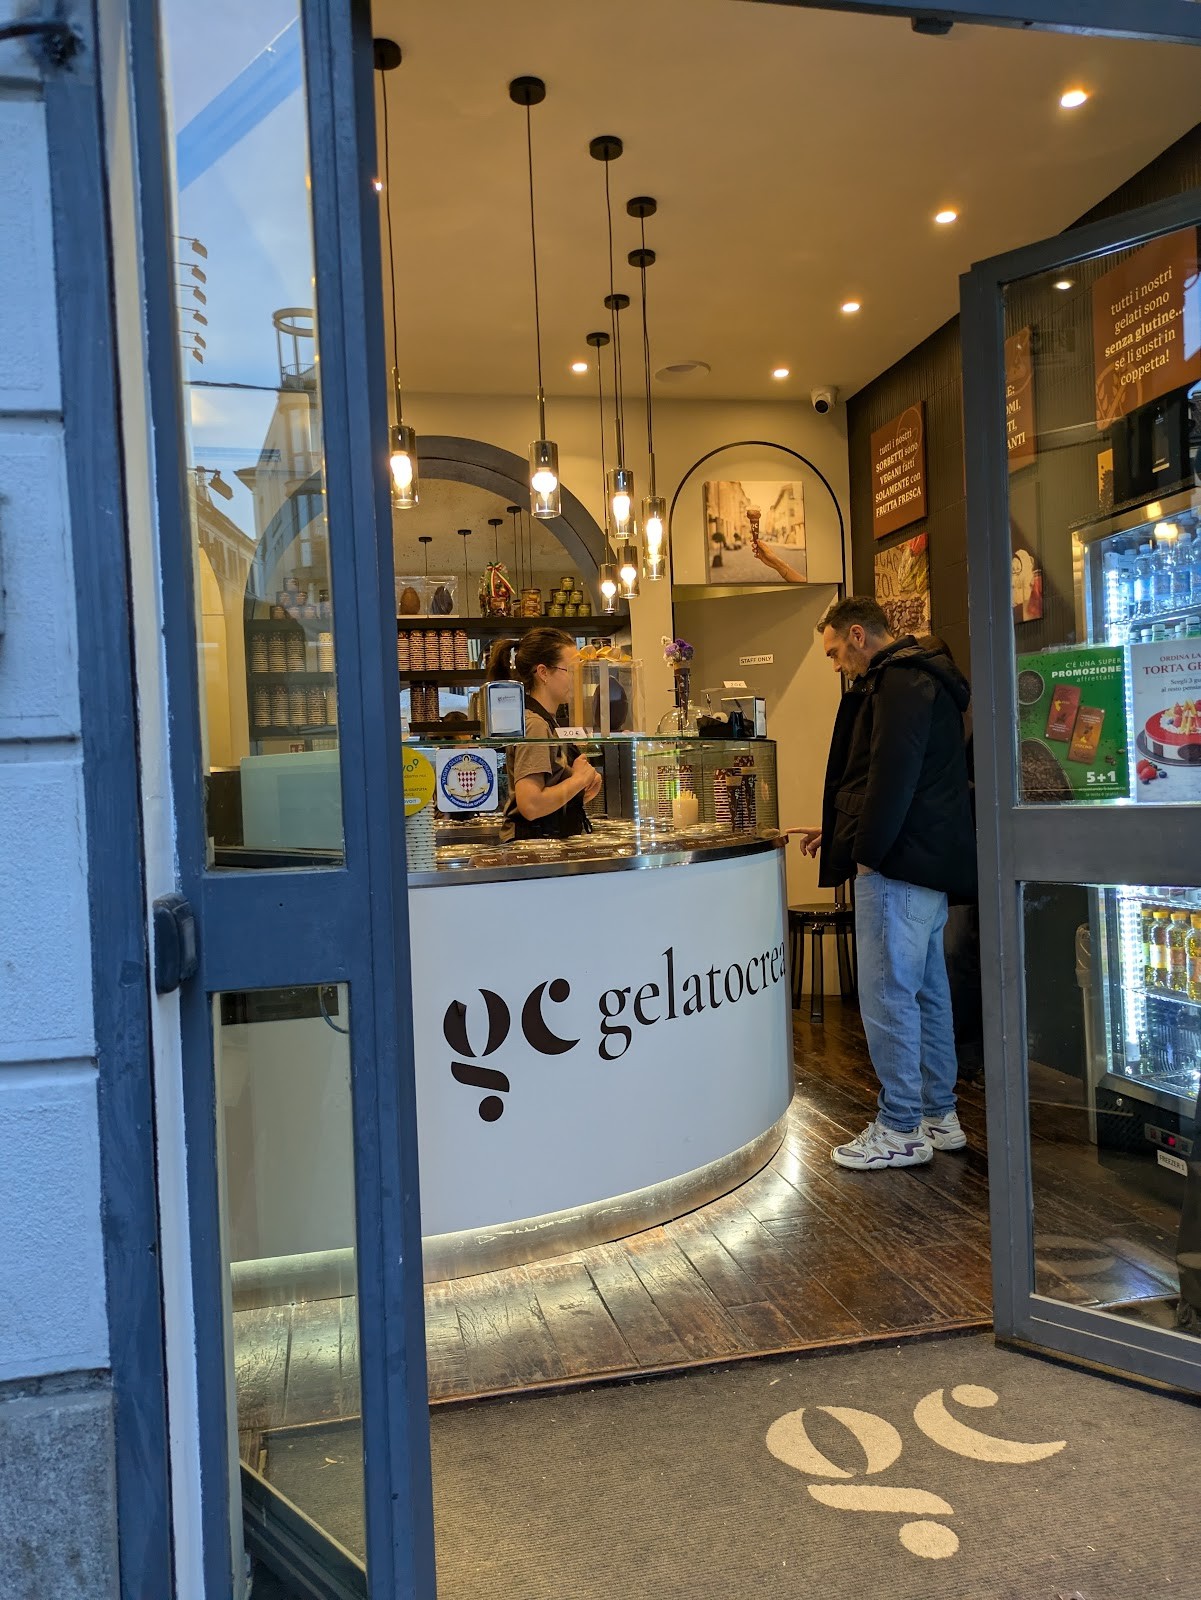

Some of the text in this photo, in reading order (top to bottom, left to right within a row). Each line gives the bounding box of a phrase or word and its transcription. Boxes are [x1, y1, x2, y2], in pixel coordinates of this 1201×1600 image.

[1111, 266, 1172, 315] tutti i nostri
[1114, 292, 1170, 335] gelati sono
[1104, 333, 1134, 357] senza
[1114, 329, 1176, 371] se li gusti in
[1120, 349, 1170, 386] coppetta!
[879, 440, 892, 456] tutti
[896, 428, 912, 445] nostri
[876, 442, 919, 473] SORBETTI sono
[880, 458, 915, 485] VEGANI fatti
[876, 472, 921, 503] SOLAMENTE con
[876, 486, 922, 518] FRUTTA FRESCA
[1051, 664, 1122, 678] PROMOZIONE
[1079, 660, 1096, 668] UNA
[1098, 657, 1122, 666] SUPER
[1142, 664, 1184, 675] TORTA
[1160, 654, 1189, 662] ORDINA
[478, 758, 493, 781] MONACO
[1086, 770, 1116, 783] 5+1
[1159, 1154, 1181, 1169] FREEZER
